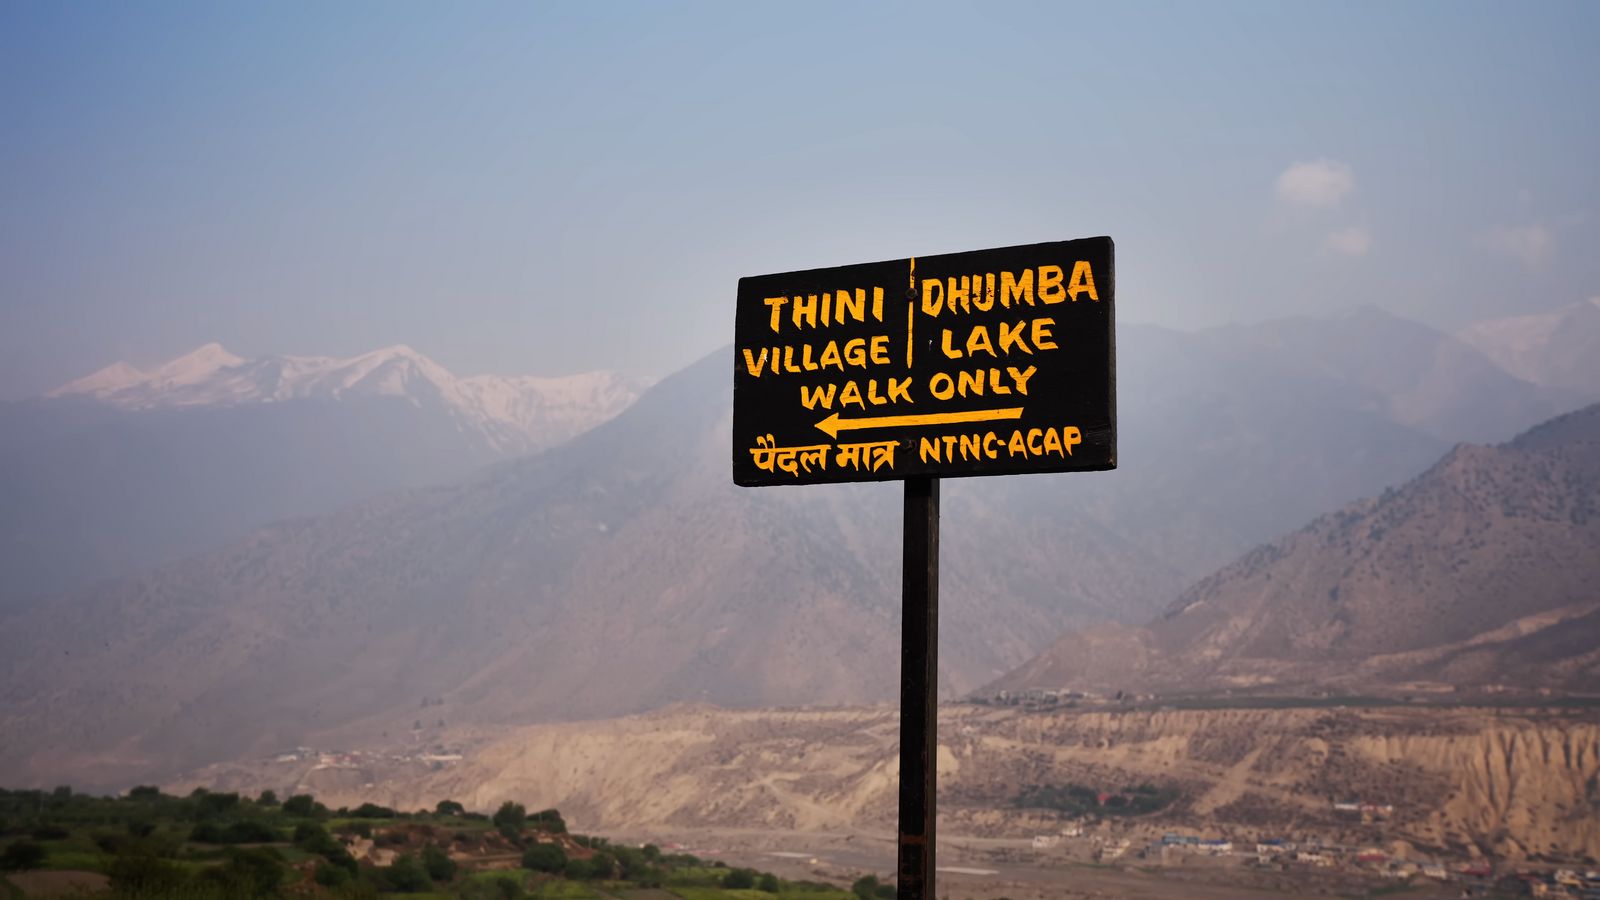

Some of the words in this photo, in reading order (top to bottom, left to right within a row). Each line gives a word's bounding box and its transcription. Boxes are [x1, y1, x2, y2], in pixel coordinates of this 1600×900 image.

[763, 286, 885, 334] THINI
[921, 260, 1099, 318] DHUMBA
[742, 335, 891, 378] VILLAGE
[941, 317, 1059, 361] LAKE
[800, 376, 914, 411] WALK
[928, 364, 1038, 401] ONLY
[748, 433, 832, 478] पैदल
[835, 440, 901, 473] मात्र
[919, 426, 1082, 464] NTNC-ACAP
